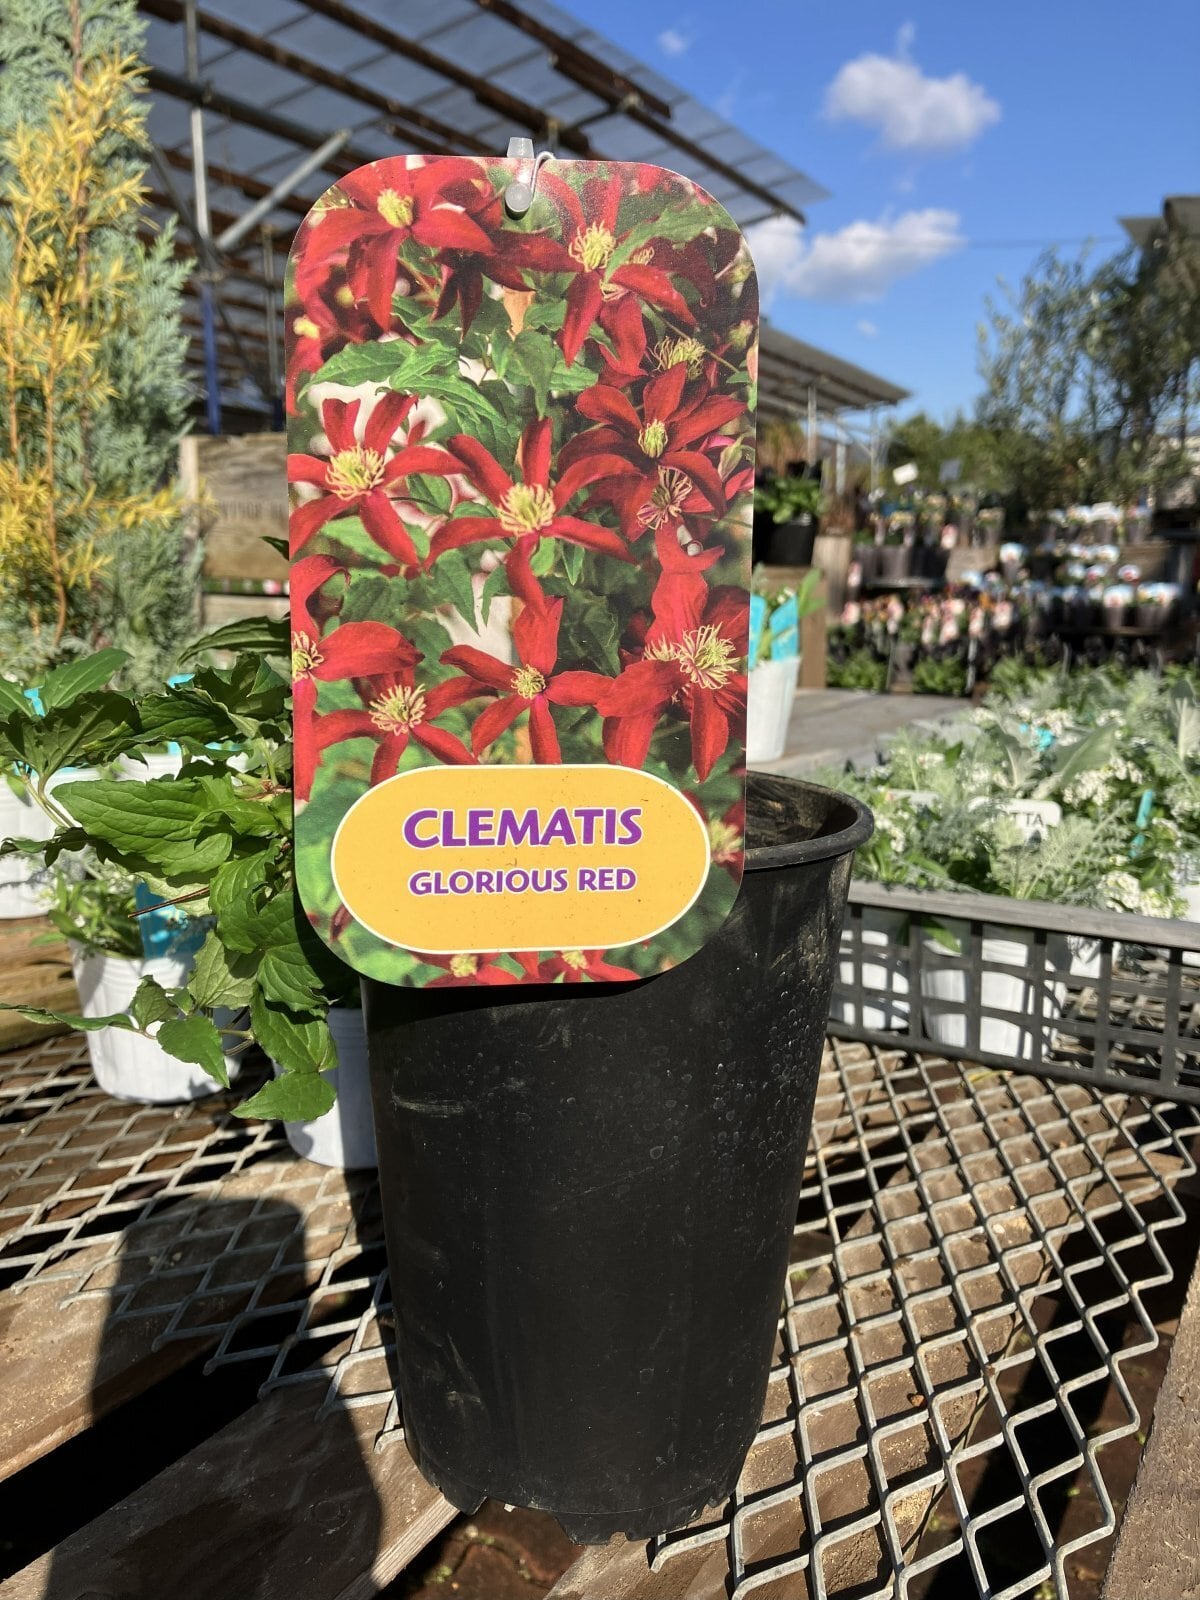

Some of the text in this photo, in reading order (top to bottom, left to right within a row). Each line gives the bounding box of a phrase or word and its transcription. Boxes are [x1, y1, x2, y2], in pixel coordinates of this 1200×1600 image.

[403, 807, 643, 849] CLEMATIS
[408, 868, 637, 896] GLORIOUS RED
